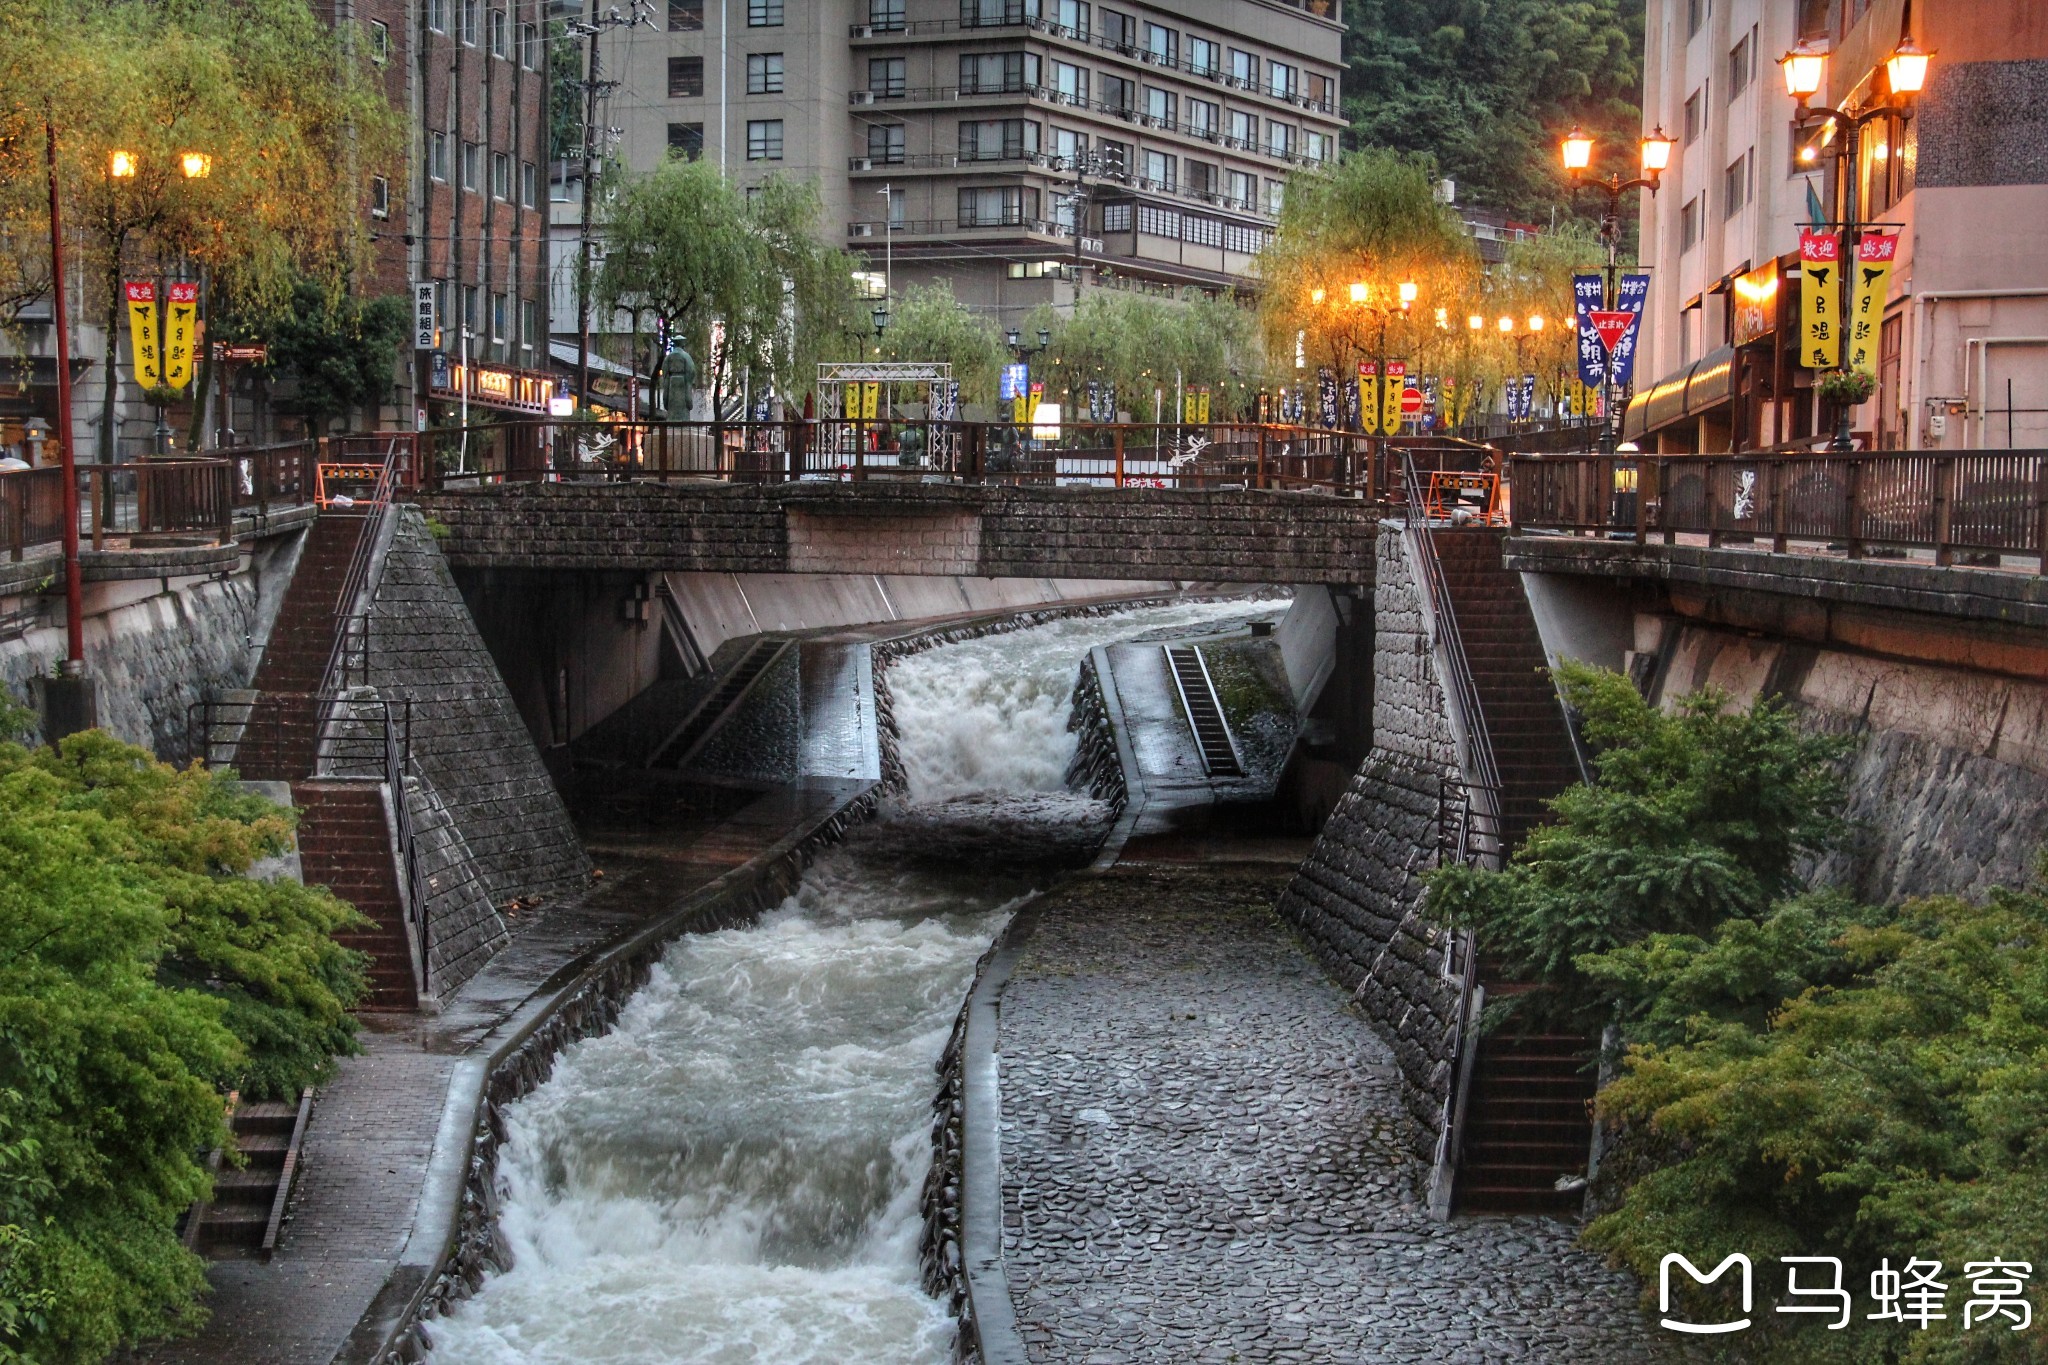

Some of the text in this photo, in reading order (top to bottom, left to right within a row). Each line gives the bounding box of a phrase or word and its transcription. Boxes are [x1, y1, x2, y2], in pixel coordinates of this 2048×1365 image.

[419, 286, 432, 346] 旅館組合
[1577, 302, 1604, 377] いゆ朝市
[1597, 319, 1625, 330] 止まれ
